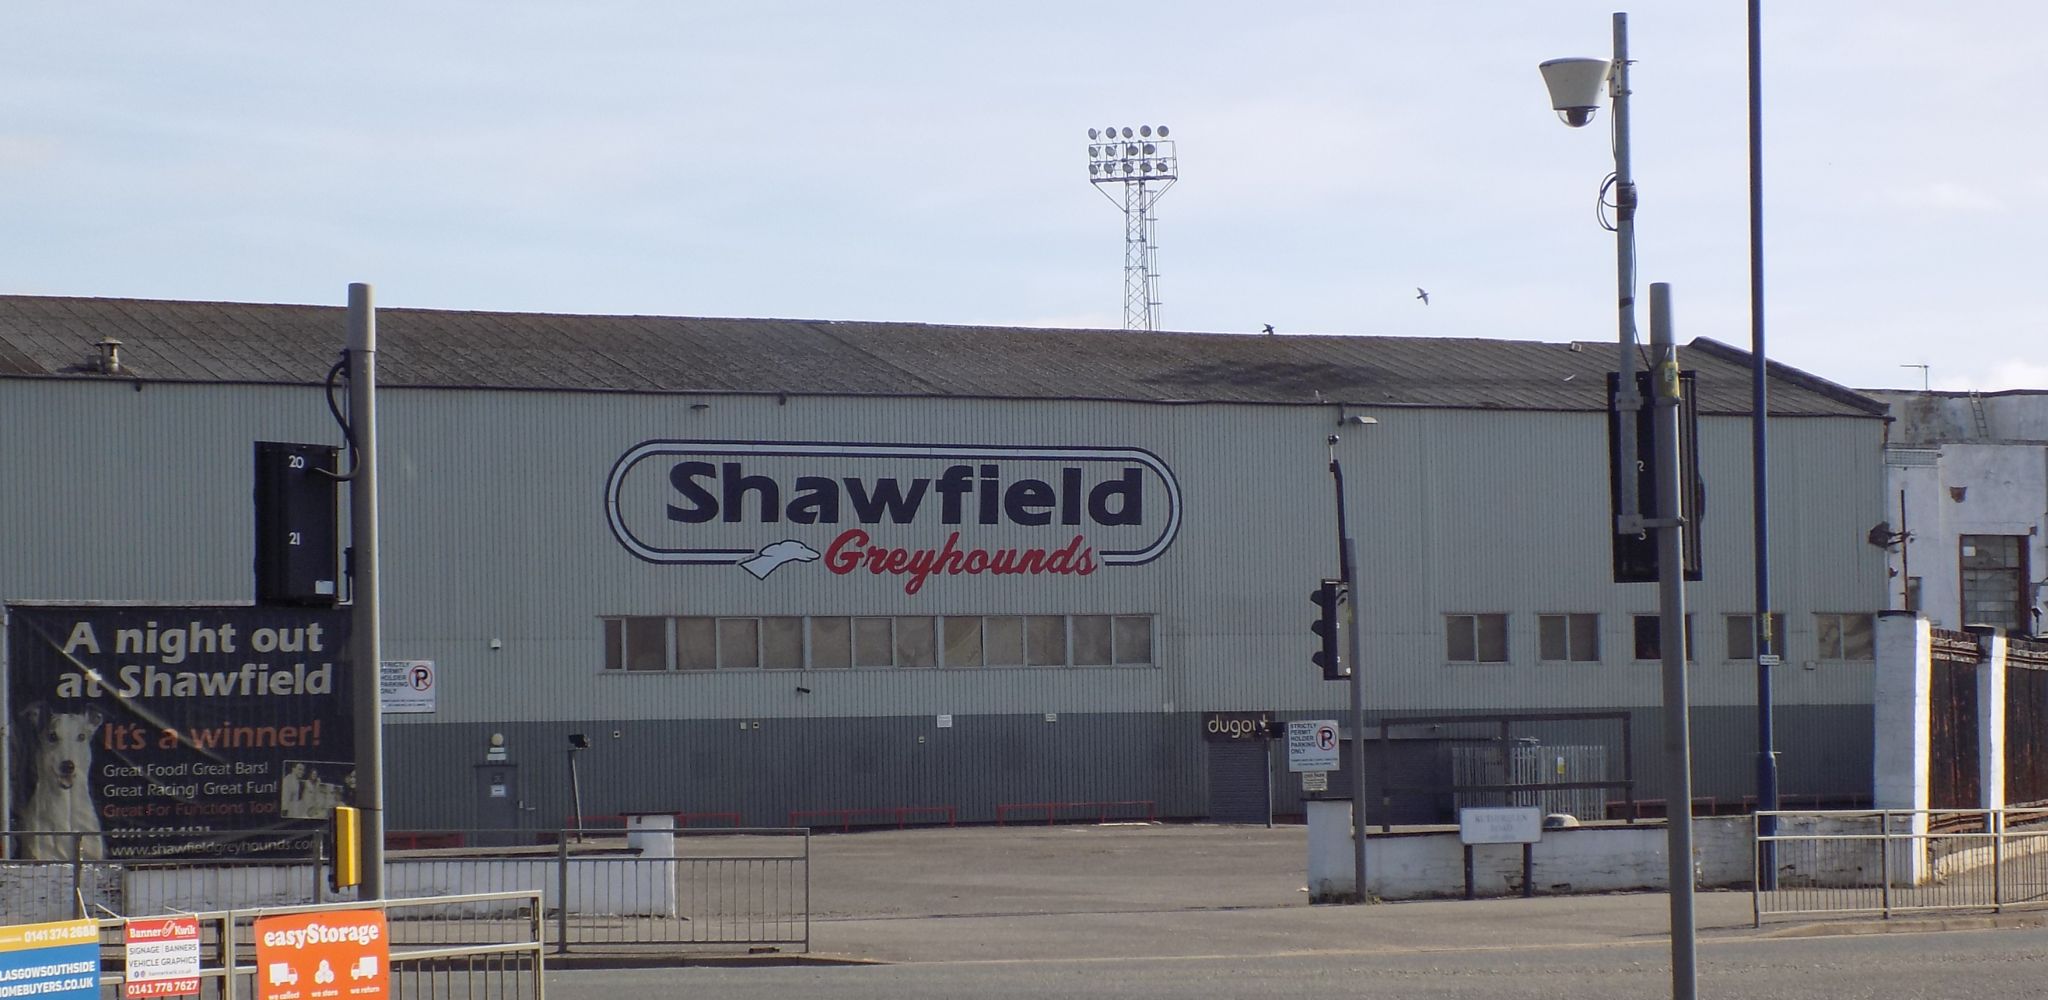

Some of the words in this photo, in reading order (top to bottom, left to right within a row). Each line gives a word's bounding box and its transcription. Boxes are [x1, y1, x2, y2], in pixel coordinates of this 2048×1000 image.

[289, 455, 304, 469] 20
[666, 461, 1143, 526] Shawfield
[289, 532, 300, 545] 21
[824, 529, 1098, 595] Greyhounds
[63, 622, 100, 653] A
[116, 621, 236, 664] night
[252, 622, 323, 652] out
[57, 666, 102, 698] at
[119, 663, 332, 697] Shawfield
[103, 722, 147, 750] It's
[158, 730, 179, 749] a
[190, 720, 321, 749] winner!
[103, 764, 143, 778] Great
[147, 763, 188, 777] Food!
[192, 763, 232, 776] Great
[236, 762, 268, 775] Bars!
[103, 783, 143, 797] Great
[147, 782, 199, 799] Racing!
[204, 781, 244, 795] Great
[247, 781, 277, 794] Fun!
[103, 803, 143, 817] Great
[147, 803, 171, 816] For
[175, 802, 244, 816] Functions
[112, 837, 317, 857] www.shawfieldgreyhounds.co
[24, 930, 48, 943] 0141
[49, 928, 68, 940] 374
[129, 928, 162, 938] Banner
[175, 925, 196, 936] Kwik
[264, 923, 379, 949] easyStorage
[129, 945, 160, 955] SIGNAGE
[165, 944, 197, 953] BANNERS
[0, 960, 95, 981] LASGOWSOUTHSIDE
[129, 958, 160, 968] VEHICLE
[161, 956, 197, 966] GRAPHICS
[128, 983, 153, 995] 0141
[155, 981, 173, 993] 778
[174, 980, 198, 991] 7627
